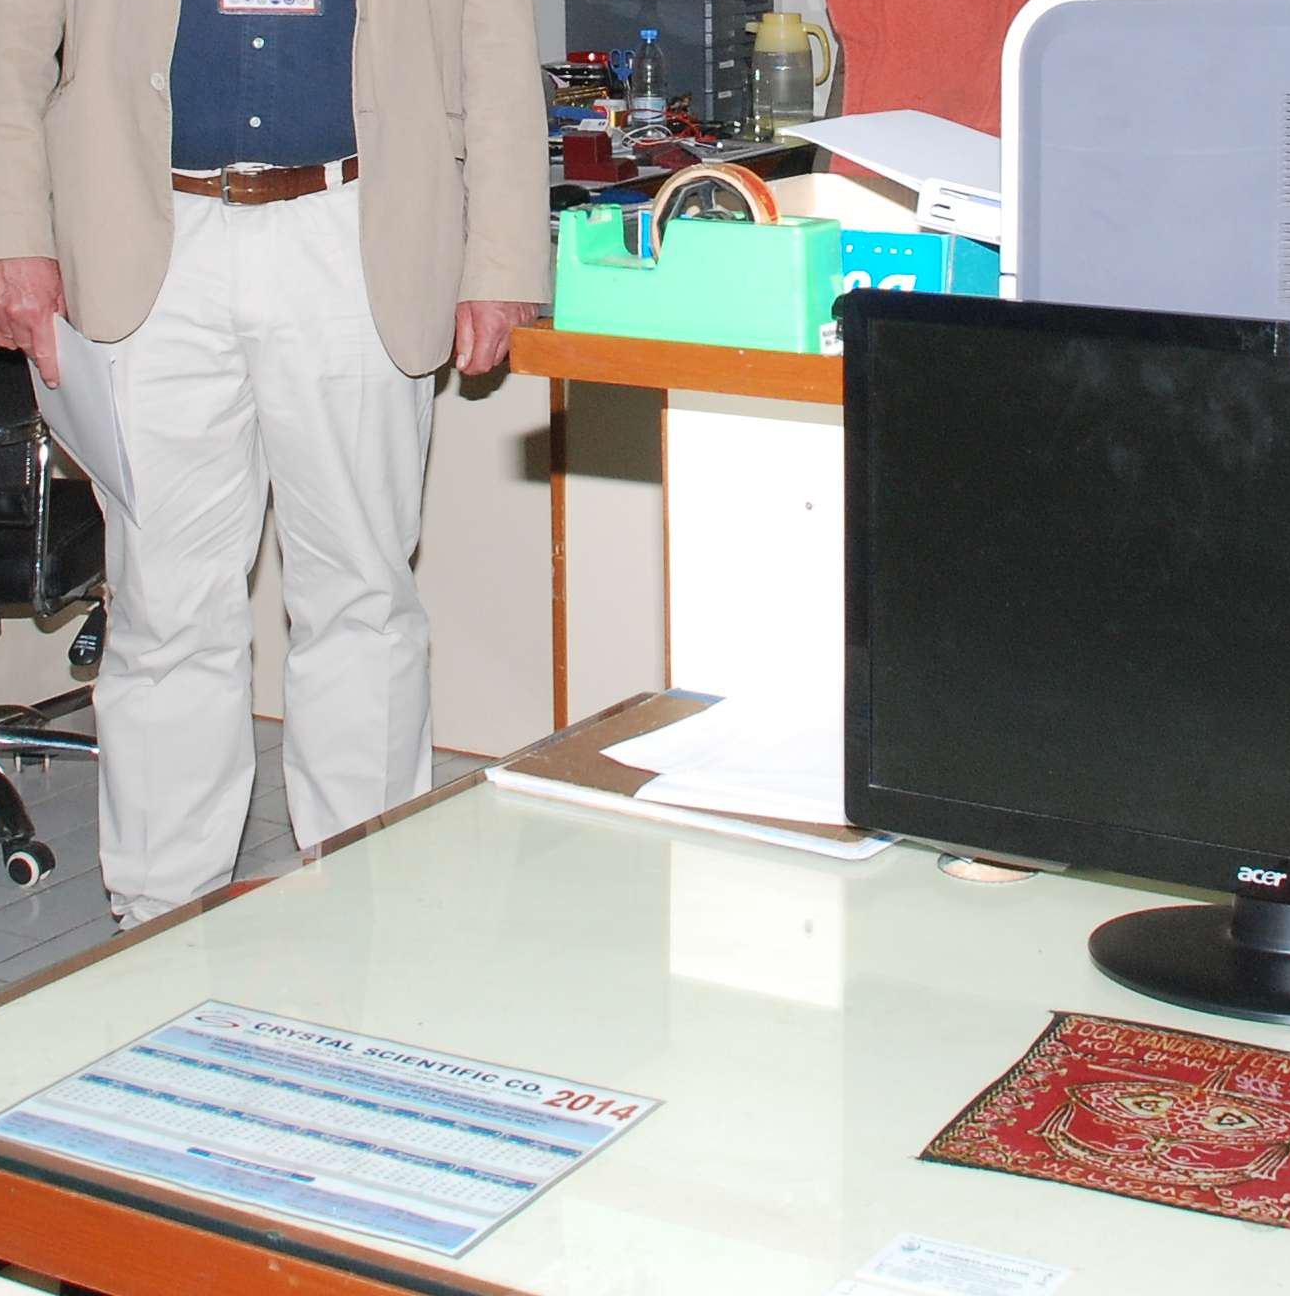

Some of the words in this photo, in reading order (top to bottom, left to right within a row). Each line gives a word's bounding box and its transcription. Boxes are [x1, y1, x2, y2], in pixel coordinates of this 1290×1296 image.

[1237, 866, 1287, 887] acer
[1078, 1039, 1135, 1055] KOTA
[1143, 1050, 1220, 1073] BHARU
[1133, 1033, 1247, 1065] HANDICRAFT
[254, 1021, 354, 1052] CRYSTAL
[363, 1047, 500, 1083] SCIENTIFIC
[505, 1077, 544, 1096] CO.
[542, 1090, 640, 1121] 2014
[1043, 1160, 1198, 1204] WELCOME
